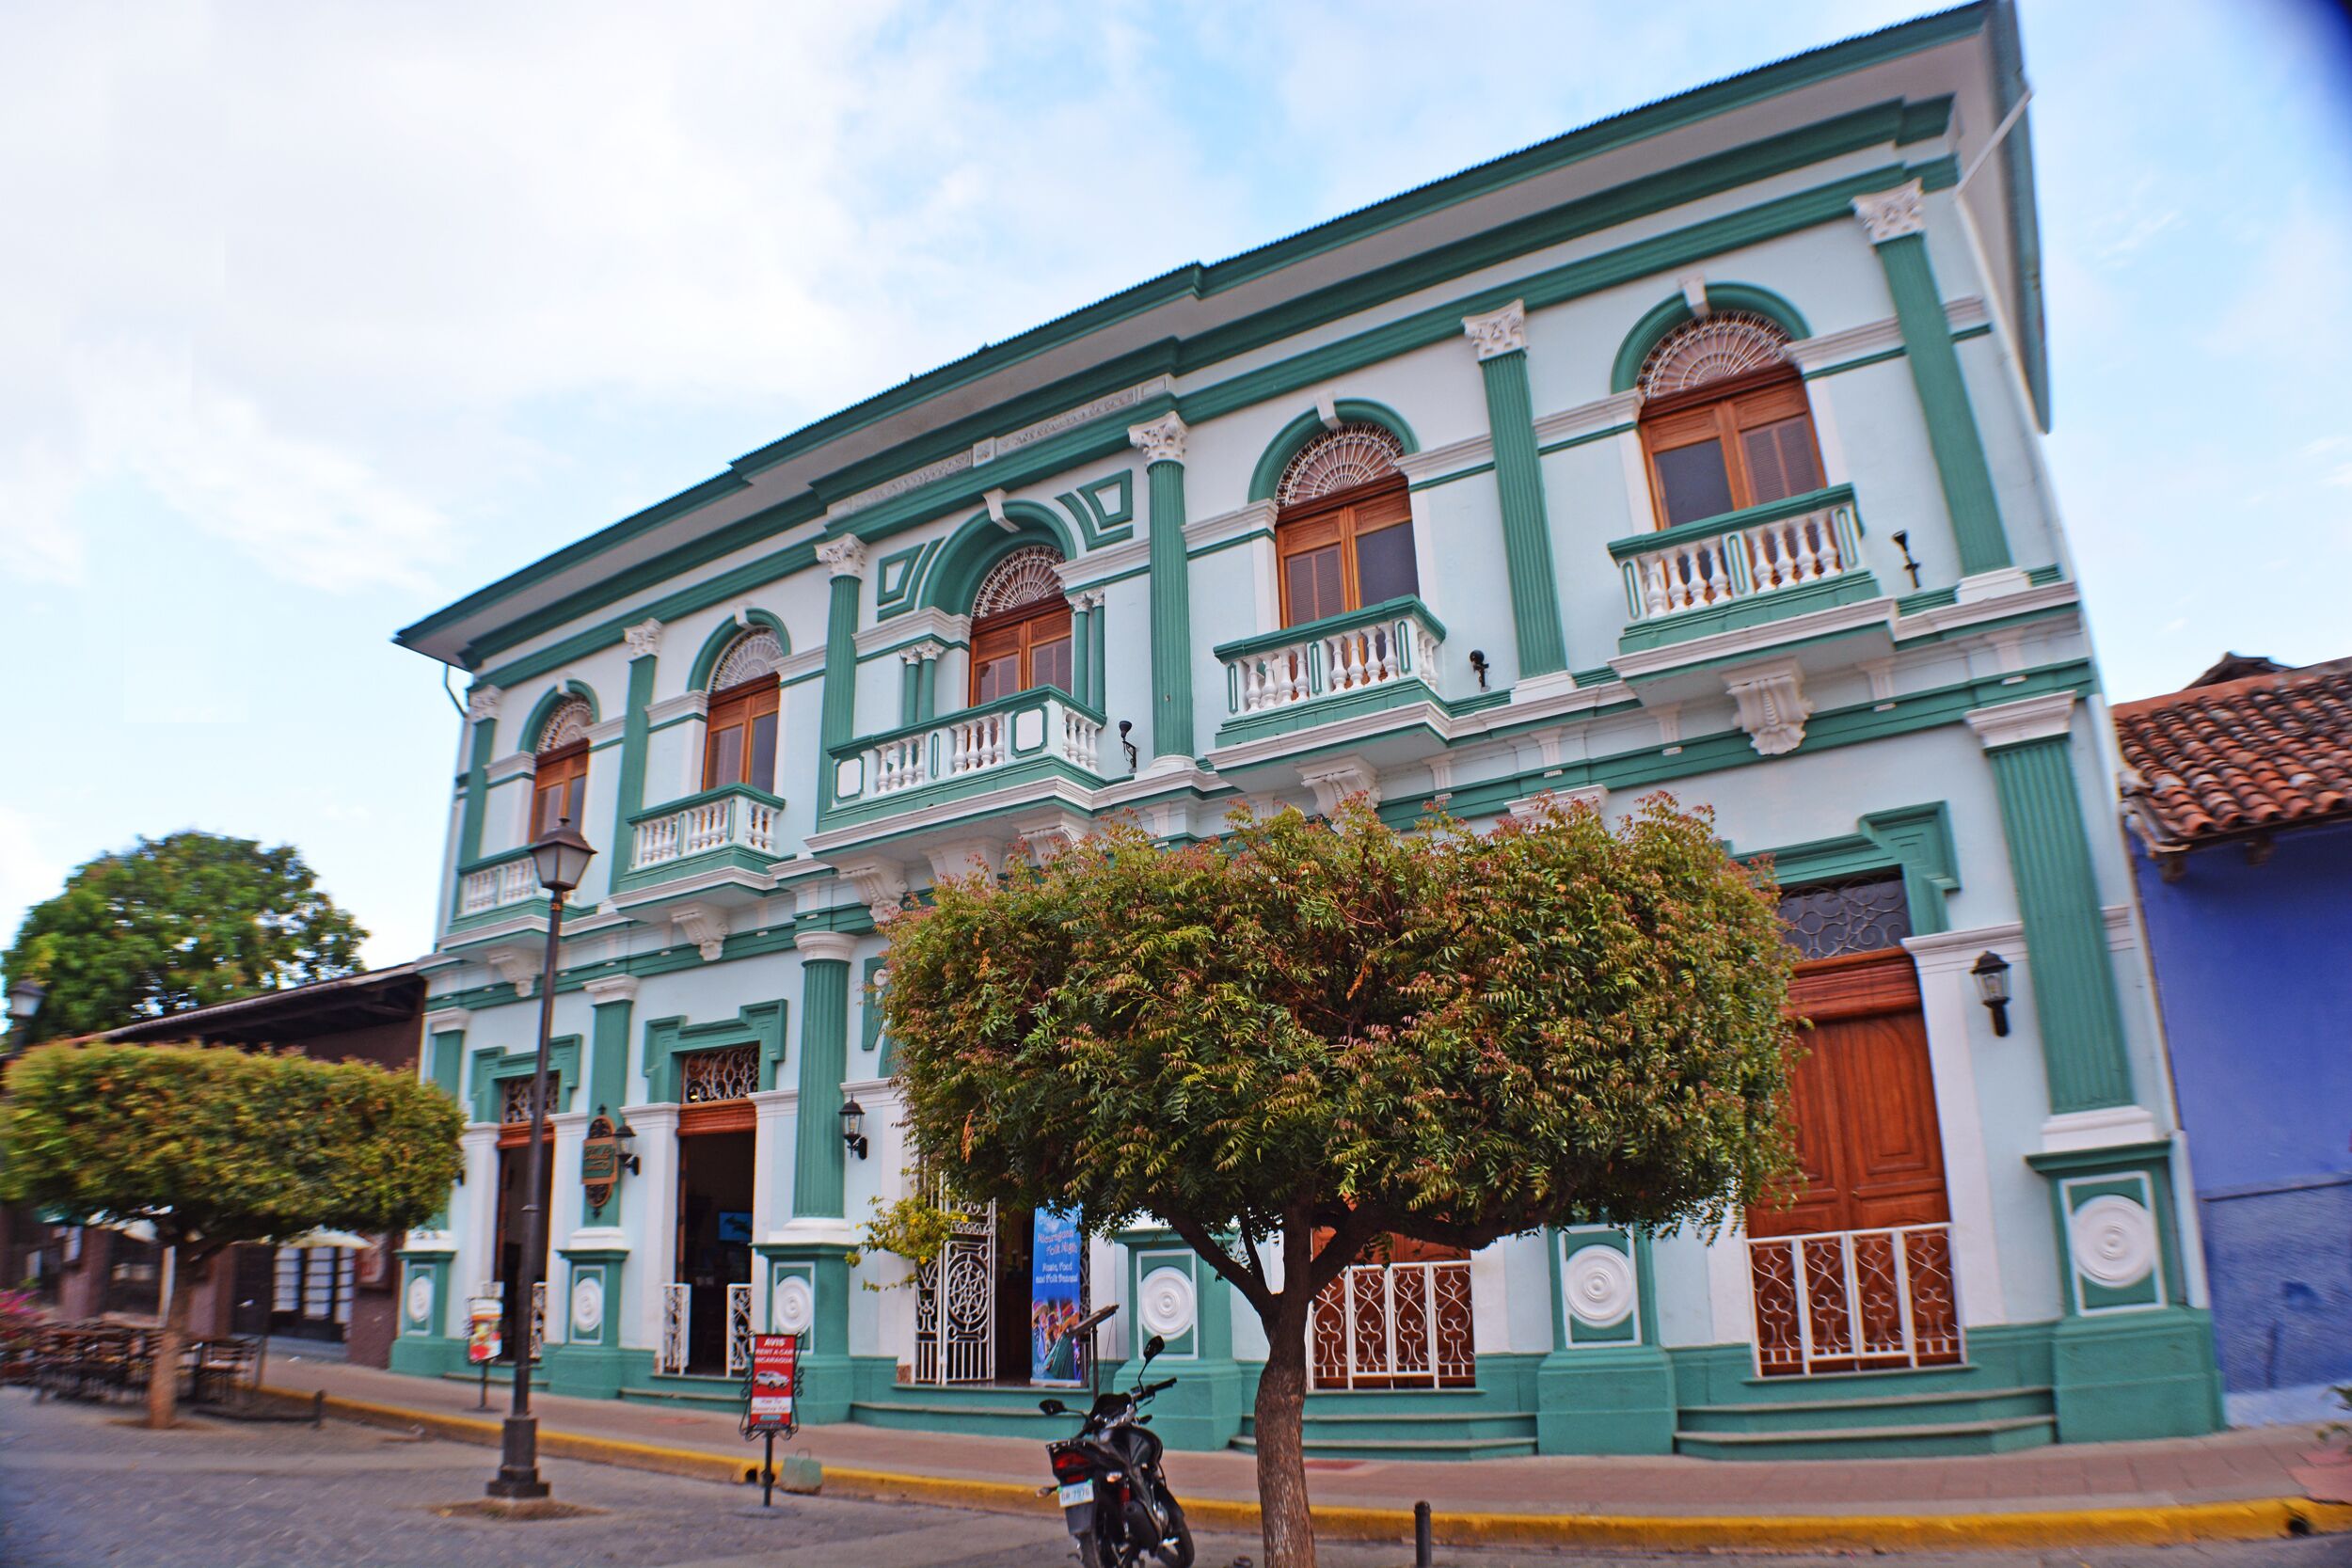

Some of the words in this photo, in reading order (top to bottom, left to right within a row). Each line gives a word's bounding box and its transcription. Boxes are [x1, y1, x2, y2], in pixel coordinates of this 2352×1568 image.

[1046, 1243, 1060, 1257] Folk
[1059, 1261, 1073, 1271] Food
[1046, 1274, 1057, 1283] Folk
[764, 1338, 785, 1346] AVIS
